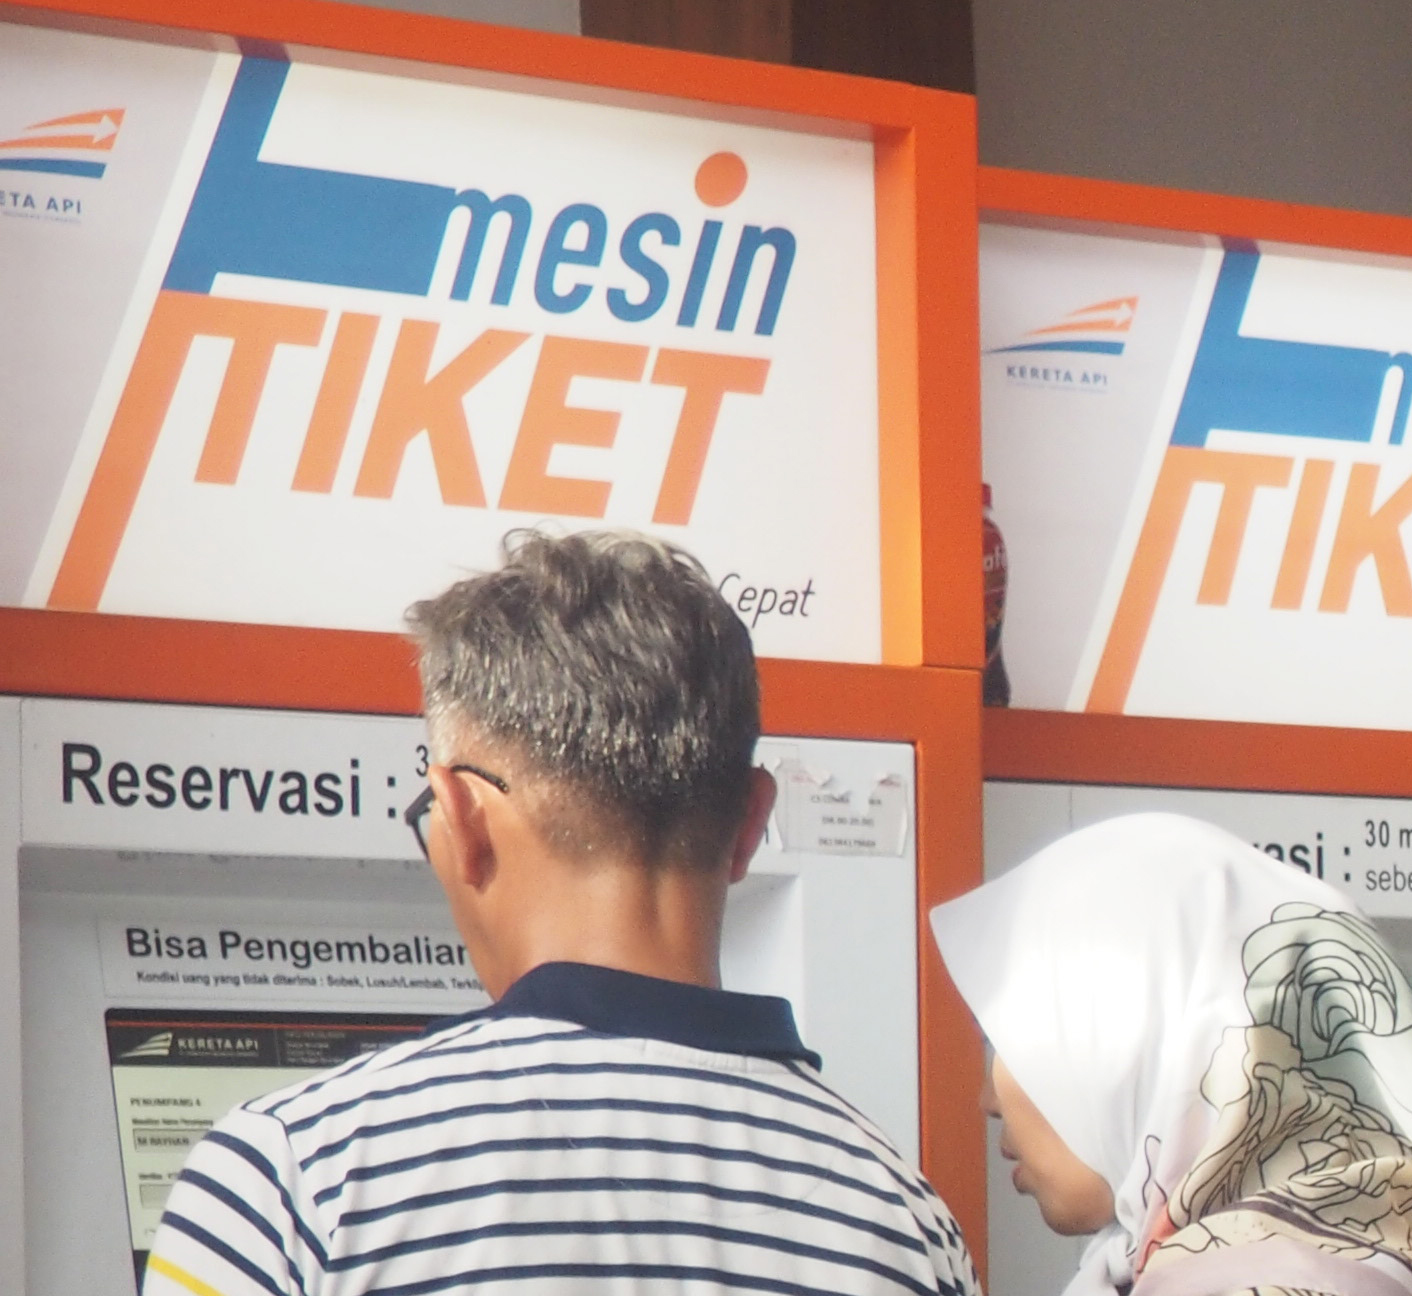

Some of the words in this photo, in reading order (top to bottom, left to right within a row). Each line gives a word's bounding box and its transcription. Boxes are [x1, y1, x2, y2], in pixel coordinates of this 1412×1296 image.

[0, 190, 35, 209] ETA
[46, 197, 81, 214] API
[428, 151, 797, 337] mesin
[1006, 365, 1072, 382] KERETA
[1081, 370, 1107, 385] API
[160, 290, 771, 526] TIKET
[717, 572, 815, 629] Cepat
[62, 741, 361, 817] Reservasi
[1365, 820, 1390, 848] 30
[125, 928, 207, 960] Bisa
